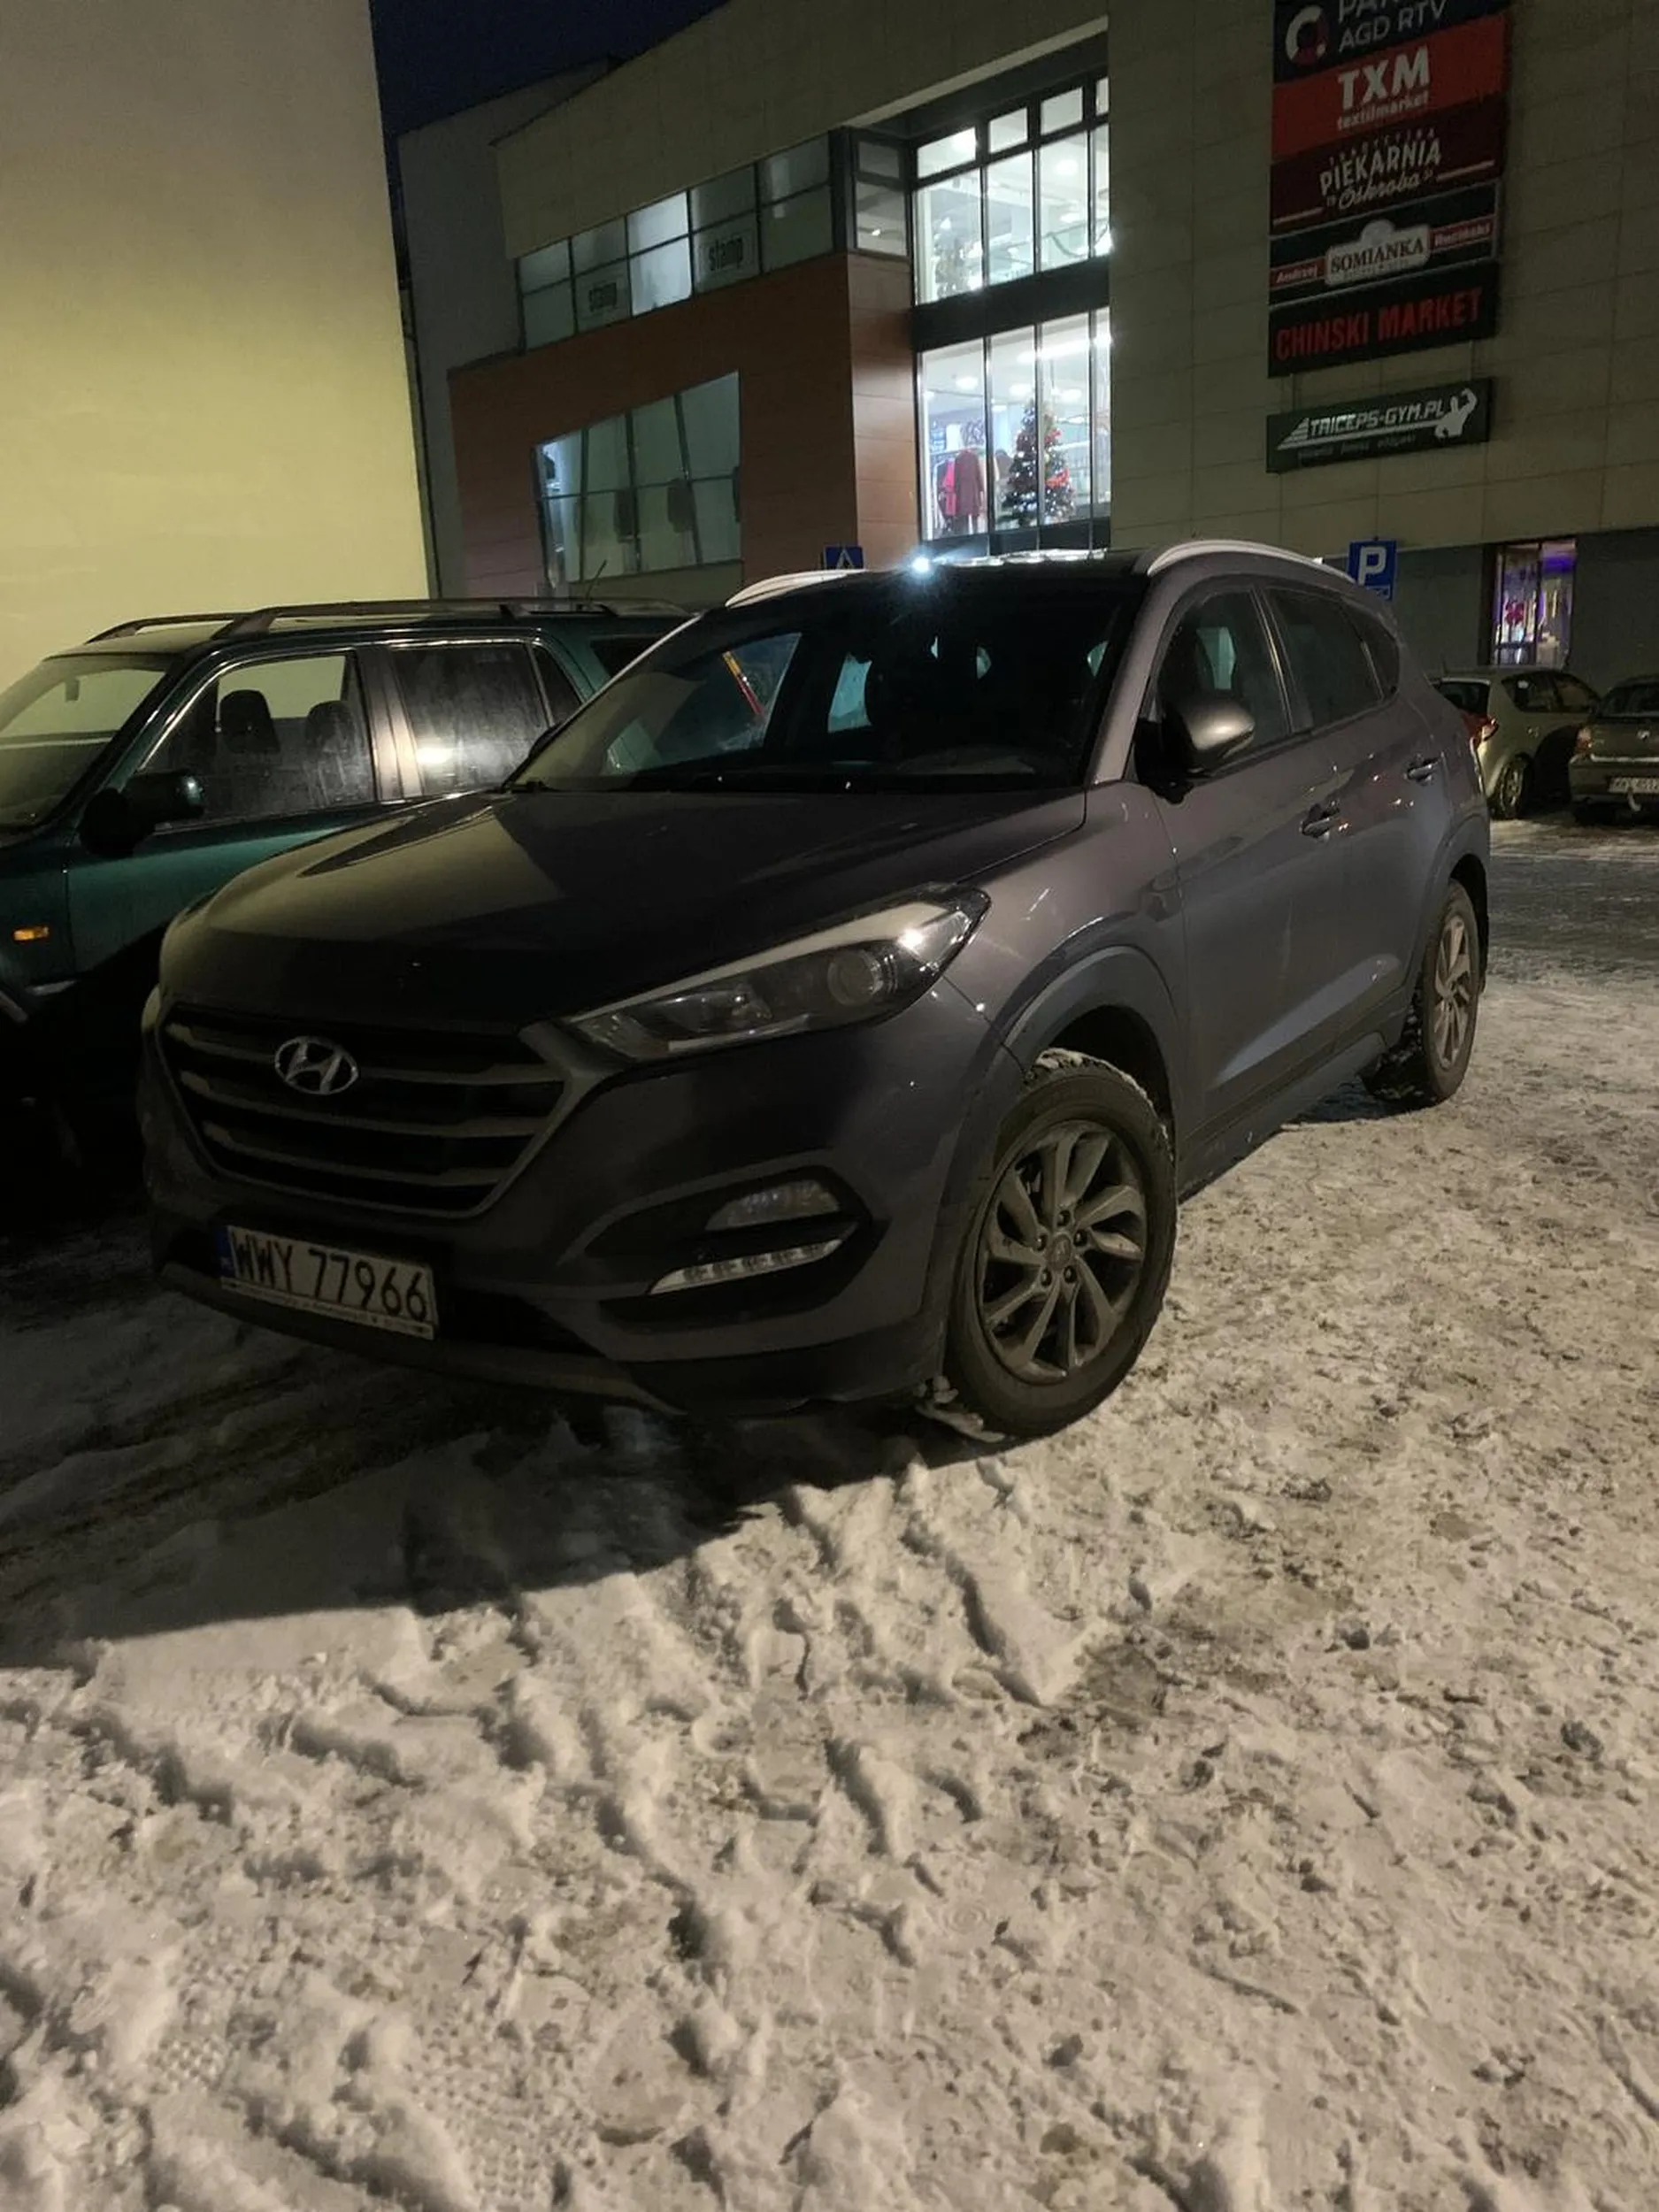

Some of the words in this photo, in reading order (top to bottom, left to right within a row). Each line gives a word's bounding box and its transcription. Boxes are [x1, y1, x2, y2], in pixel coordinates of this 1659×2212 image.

[1339, 16, 1390, 53] AGD
[1397, 0, 1446, 32] RTV
[1337, 44, 1430, 111] TXM
[1319, 138, 1441, 196] PIEKARNIA
[1331, 238, 1424, 273] SOMIANKA
[1378, 288, 1482, 342] MARKET
[1358, 545, 1387, 587] P
[232, 1231, 293, 1294] WWY
[308, 1248, 426, 1322] 77966
